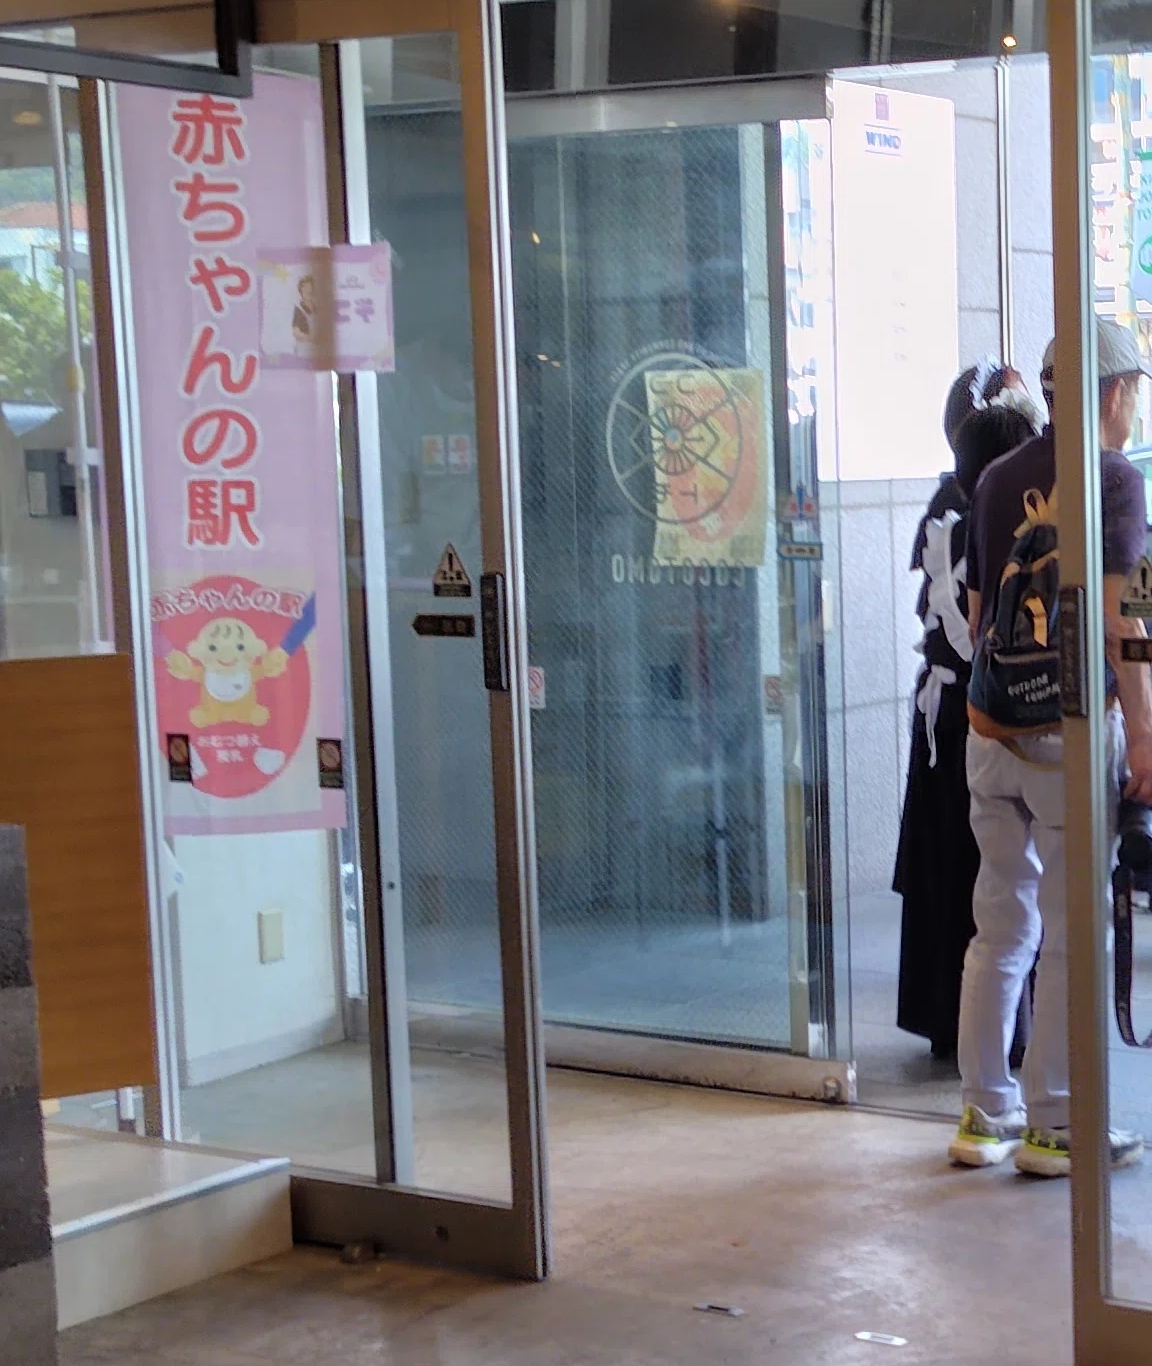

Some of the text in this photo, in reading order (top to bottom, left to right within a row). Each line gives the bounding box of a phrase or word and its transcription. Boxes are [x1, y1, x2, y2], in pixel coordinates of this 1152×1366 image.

[170, 95, 261, 547] 赤ちゃんの駅
